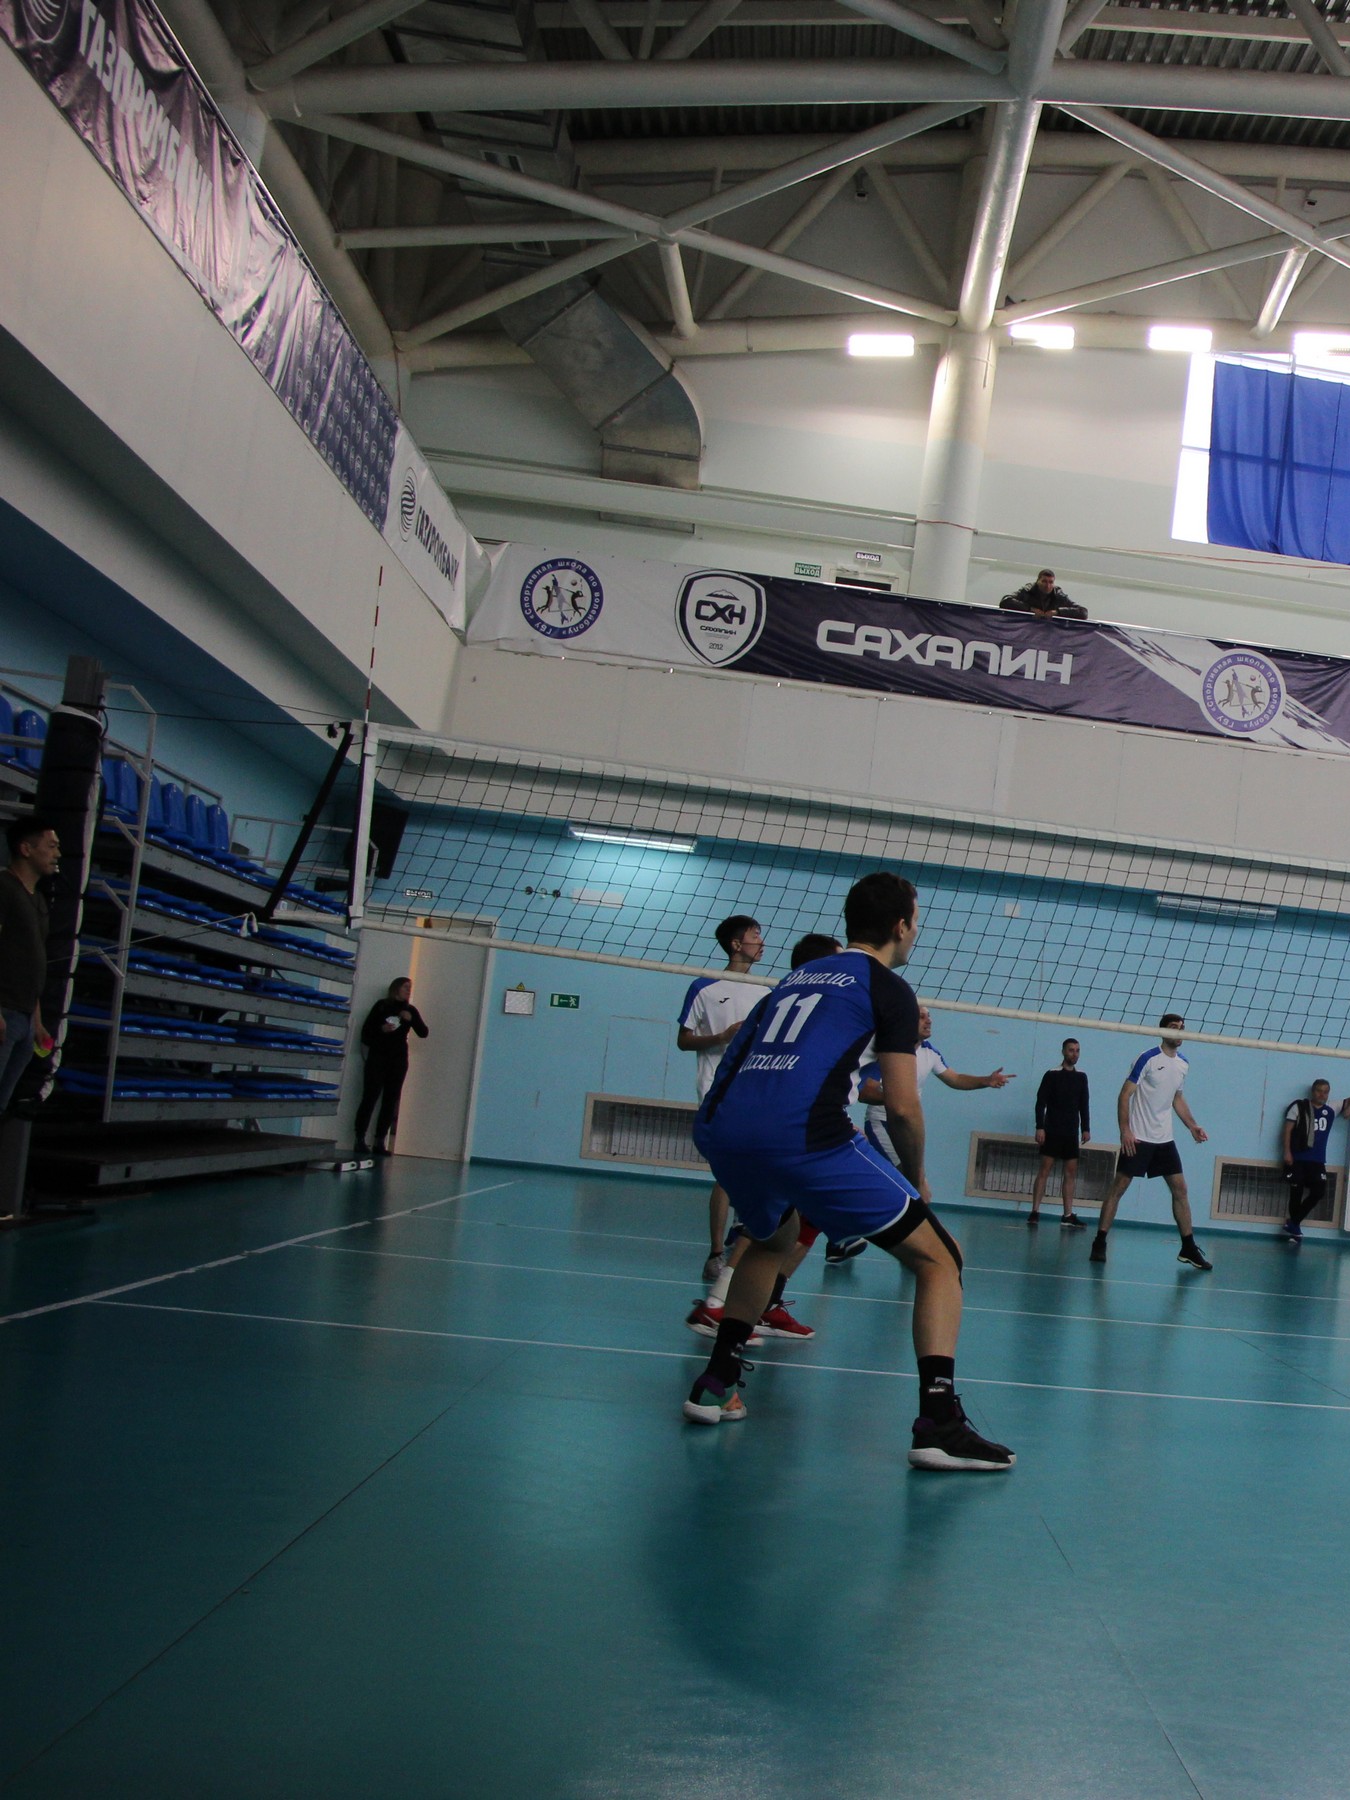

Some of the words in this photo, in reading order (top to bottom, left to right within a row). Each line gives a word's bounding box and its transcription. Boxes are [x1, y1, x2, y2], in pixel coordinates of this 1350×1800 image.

[795, 567, 820, 577] ВЫХОД
[856, 552, 880, 562] ВЫХОД
[534, 620, 553, 636] ГБУ
[557, 560, 588, 574] школа
[588, 575, 599, 588] по
[816, 619, 1073, 686] САХАЛИН
[1216, 715, 1235, 728] ГБУ
[1236, 656, 1265, 670] школа
[1266, 671, 1275, 683] по
[780, 968, 858, 989] Динамо
[762, 992, 823, 1043] 11
